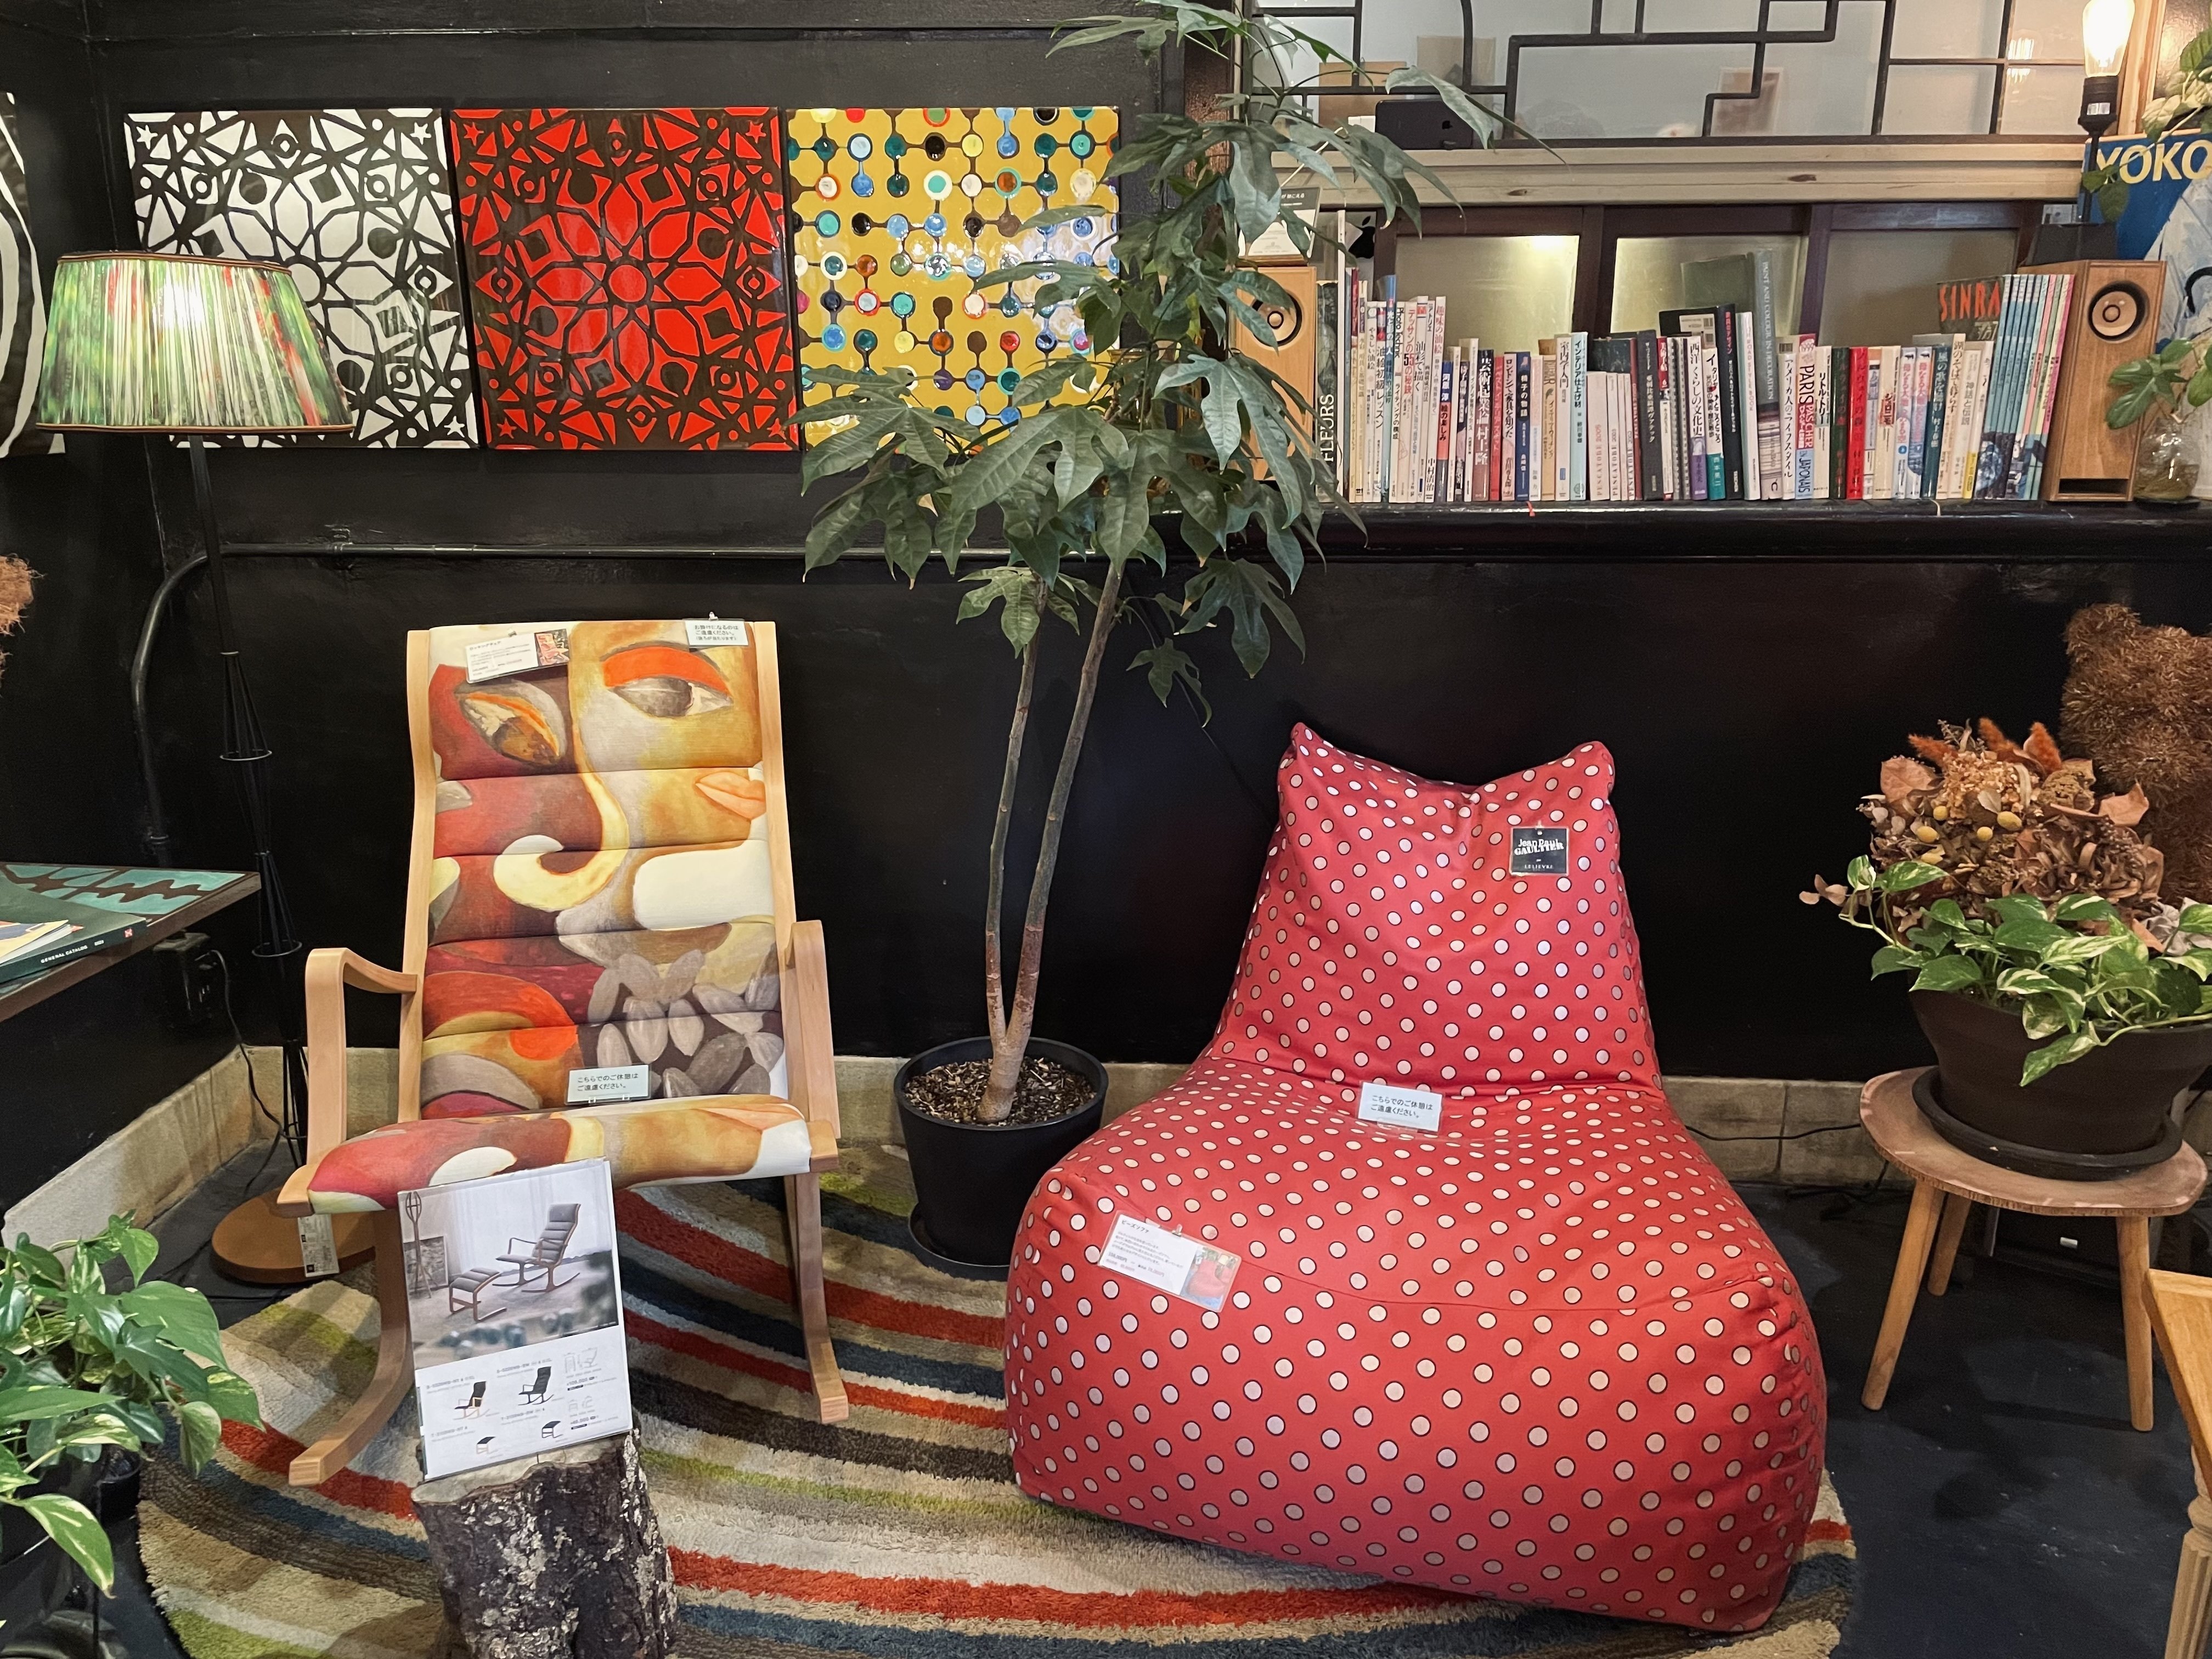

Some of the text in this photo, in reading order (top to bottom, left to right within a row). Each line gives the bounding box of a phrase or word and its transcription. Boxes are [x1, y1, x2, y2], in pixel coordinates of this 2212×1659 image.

[1939, 280, 2001, 322] SINRA
[1801, 342, 1814, 352] 1999
[1690, 343, 1704, 436] 西洋くらしの文化史
[1799, 364, 1815, 404] PARIS
[1784, 359, 1793, 478] アメリカ人のライフスタイル
[1804, 423, 1814, 449] CHER
[1475, 426, 1489, 466] 村上隆
[1798, 458, 1812, 493] JAPONAIS
[1514, 842, 1565, 856] GAULTIER
[1518, 838, 1559, 848] Jean Paul
[41, 945, 88, 963] GENERAL CATALOG
[577, 1073, 639, 1083] こちらでのご休憩は
[577, 1083, 627, 1092] ご遠慮ください。
[1372, 1094, 1434, 1110] こちらでのご休憩は
[1370, 1104, 1419, 1119] ご遠慮ください。
